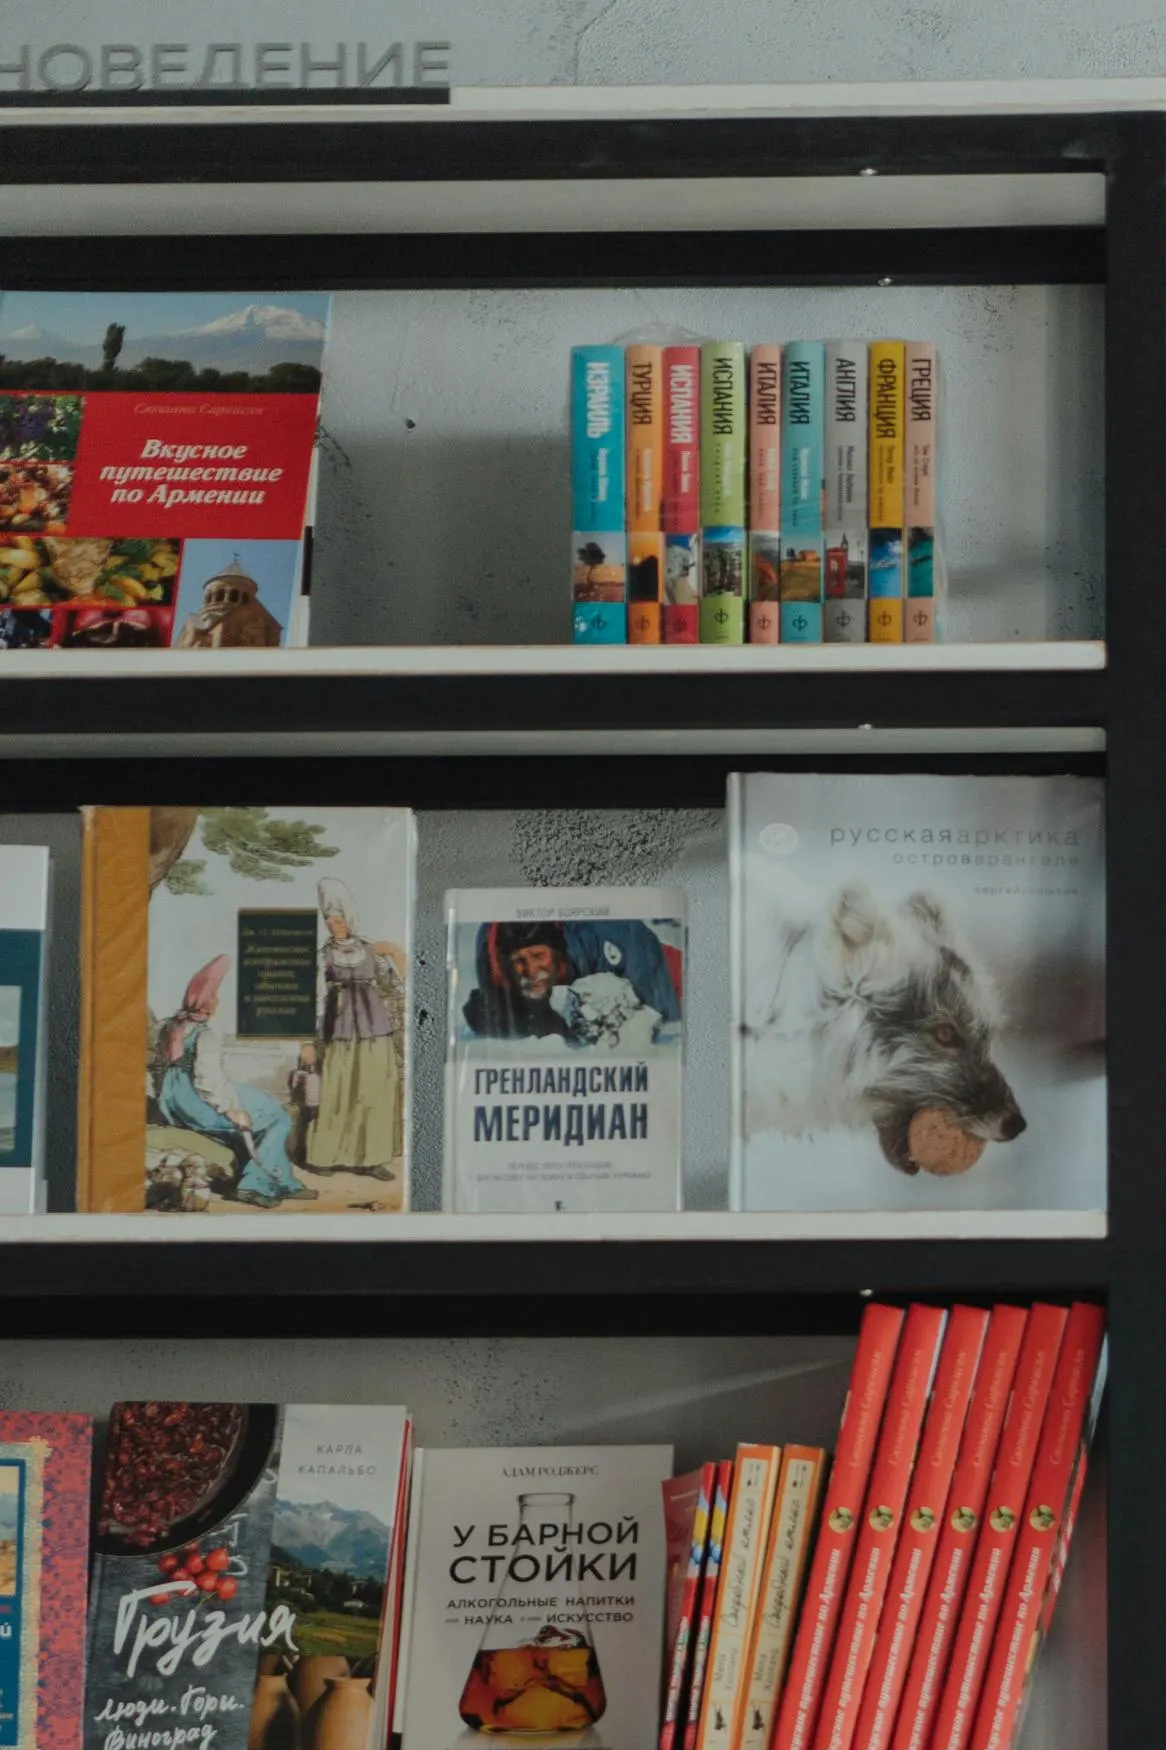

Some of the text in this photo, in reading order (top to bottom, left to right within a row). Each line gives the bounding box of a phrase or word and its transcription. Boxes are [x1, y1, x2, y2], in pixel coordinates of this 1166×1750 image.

[587, 362, 612, 438] ИЗРАИЛЬ
[631, 362, 652, 425] ТУРЦИЯ
[670, 365, 693, 444] ИСПАНИЯ
[713, 358, 733, 435] ИСПАНИЯ
[756, 362, 777, 425] ИТАЛИЯ
[790, 361, 810, 425] ИТАЛИЯ
[836, 358, 856, 423] АНГЛИЯ
[877, 358, 896, 438] ФРАНЦИЯ
[911, 358, 931, 422] ГРЕЦИЯ
[100, 465, 283, 485] путешествие
[141, 439, 247, 462] Вкусное
[110, 484, 266, 509] по Армении
[475, 1062, 648, 1097] ГРЕНЛАНДСКИЙ
[473, 1103, 648, 1146] МЕРИДИАН
[316, 1444, 363, 1454] КАРЛА
[453, 1516, 640, 1547] У БАРНОЙ
[449, 1547, 637, 1584] СТОЙКИ
[447, 1596, 634, 1609] АЛКОГОЛЬНЫЕ НАПИТКИ
[464, 1615, 513, 1625] НАУКА
[546, 1612, 633, 1623] ИСКУССТВО
[113, 1580, 299, 1679] Грузия
